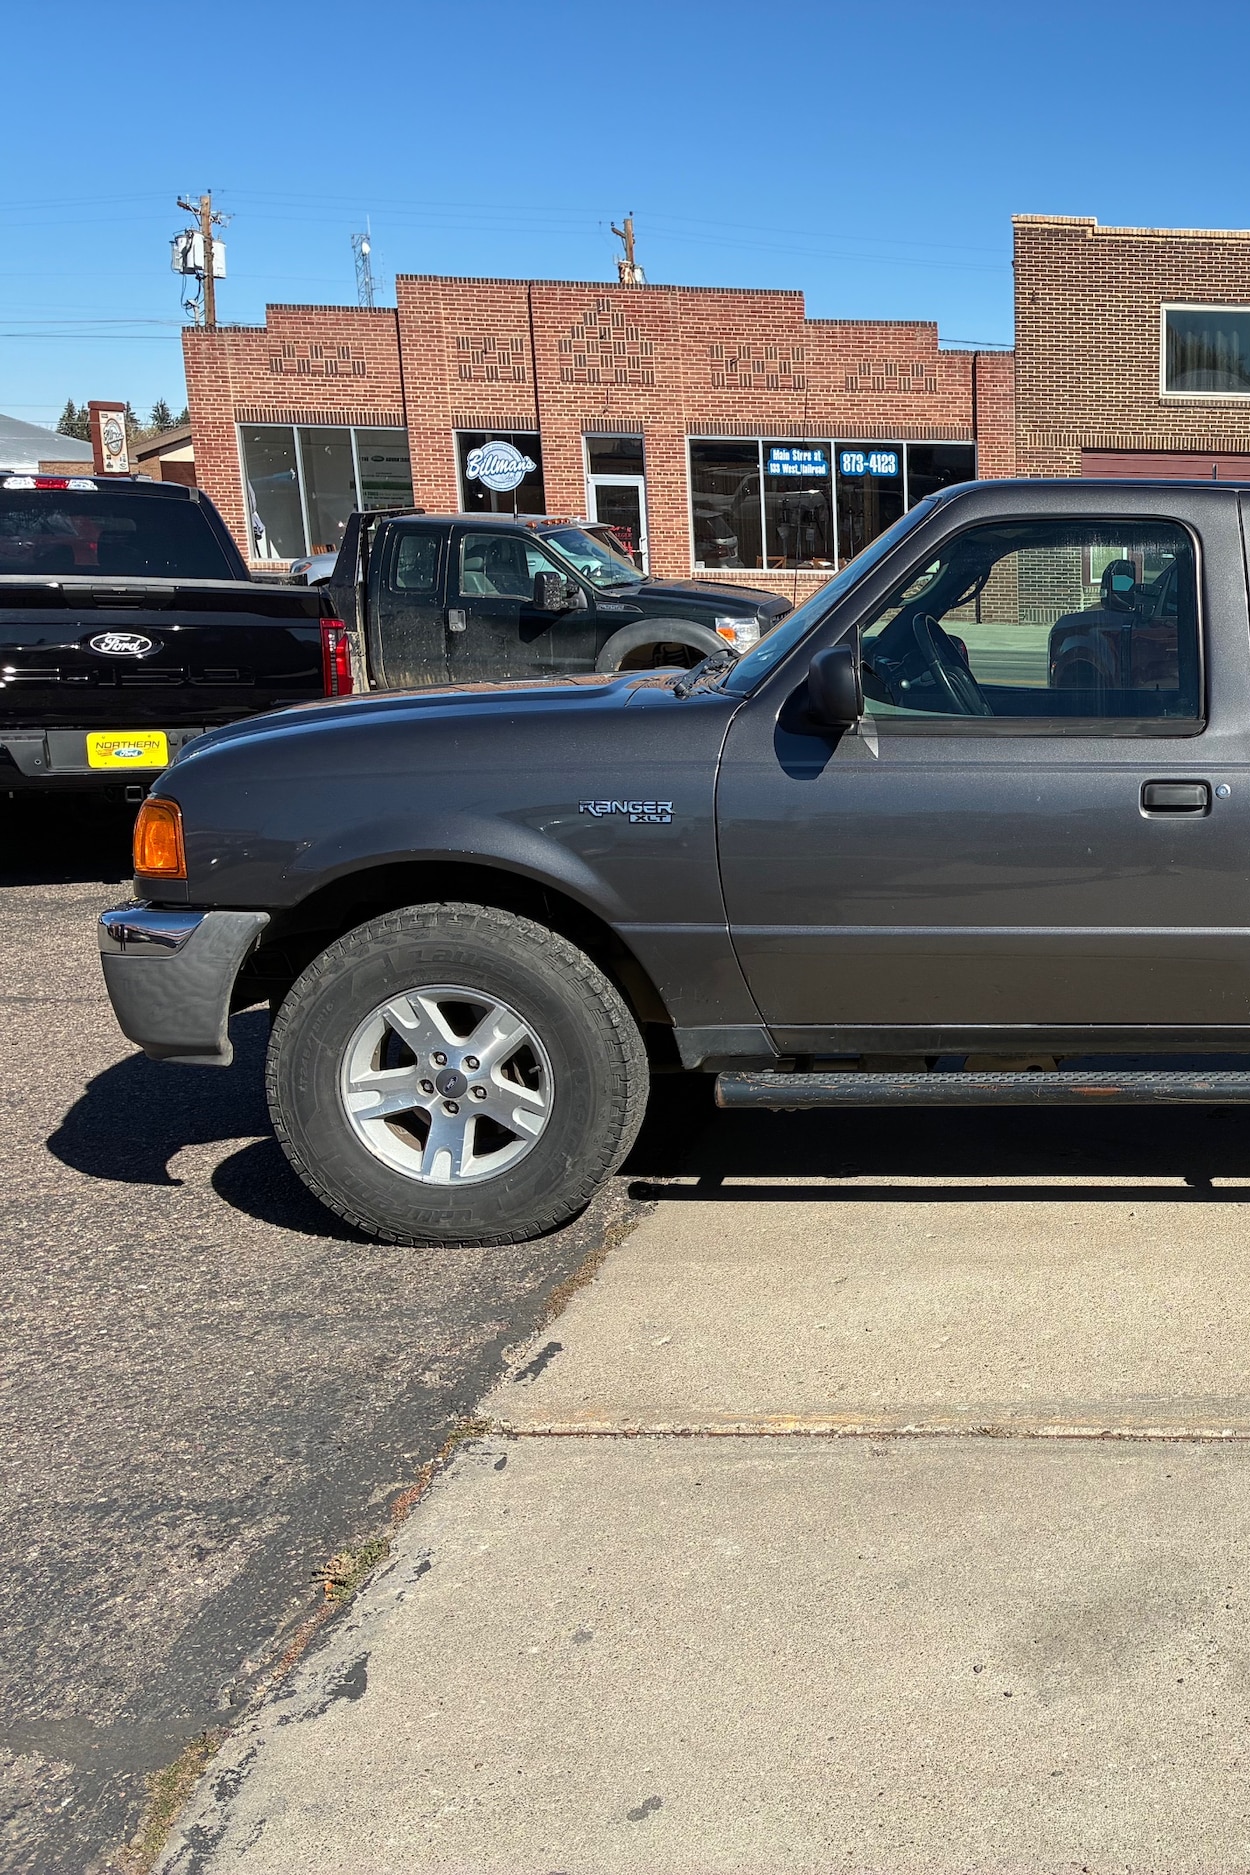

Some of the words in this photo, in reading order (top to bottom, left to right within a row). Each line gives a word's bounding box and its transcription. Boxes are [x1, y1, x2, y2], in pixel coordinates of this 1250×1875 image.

[772, 449, 790, 460] Main
[813, 450, 822, 462] at
[467, 449, 536, 478] Billman's
[782, 463, 799, 475] West
[842, 453, 896, 474] 873-4123
[101, 632, 146, 653] Ford
[95, 740, 161, 749] NORTHERN
[633, 814, 670, 823] XLT
